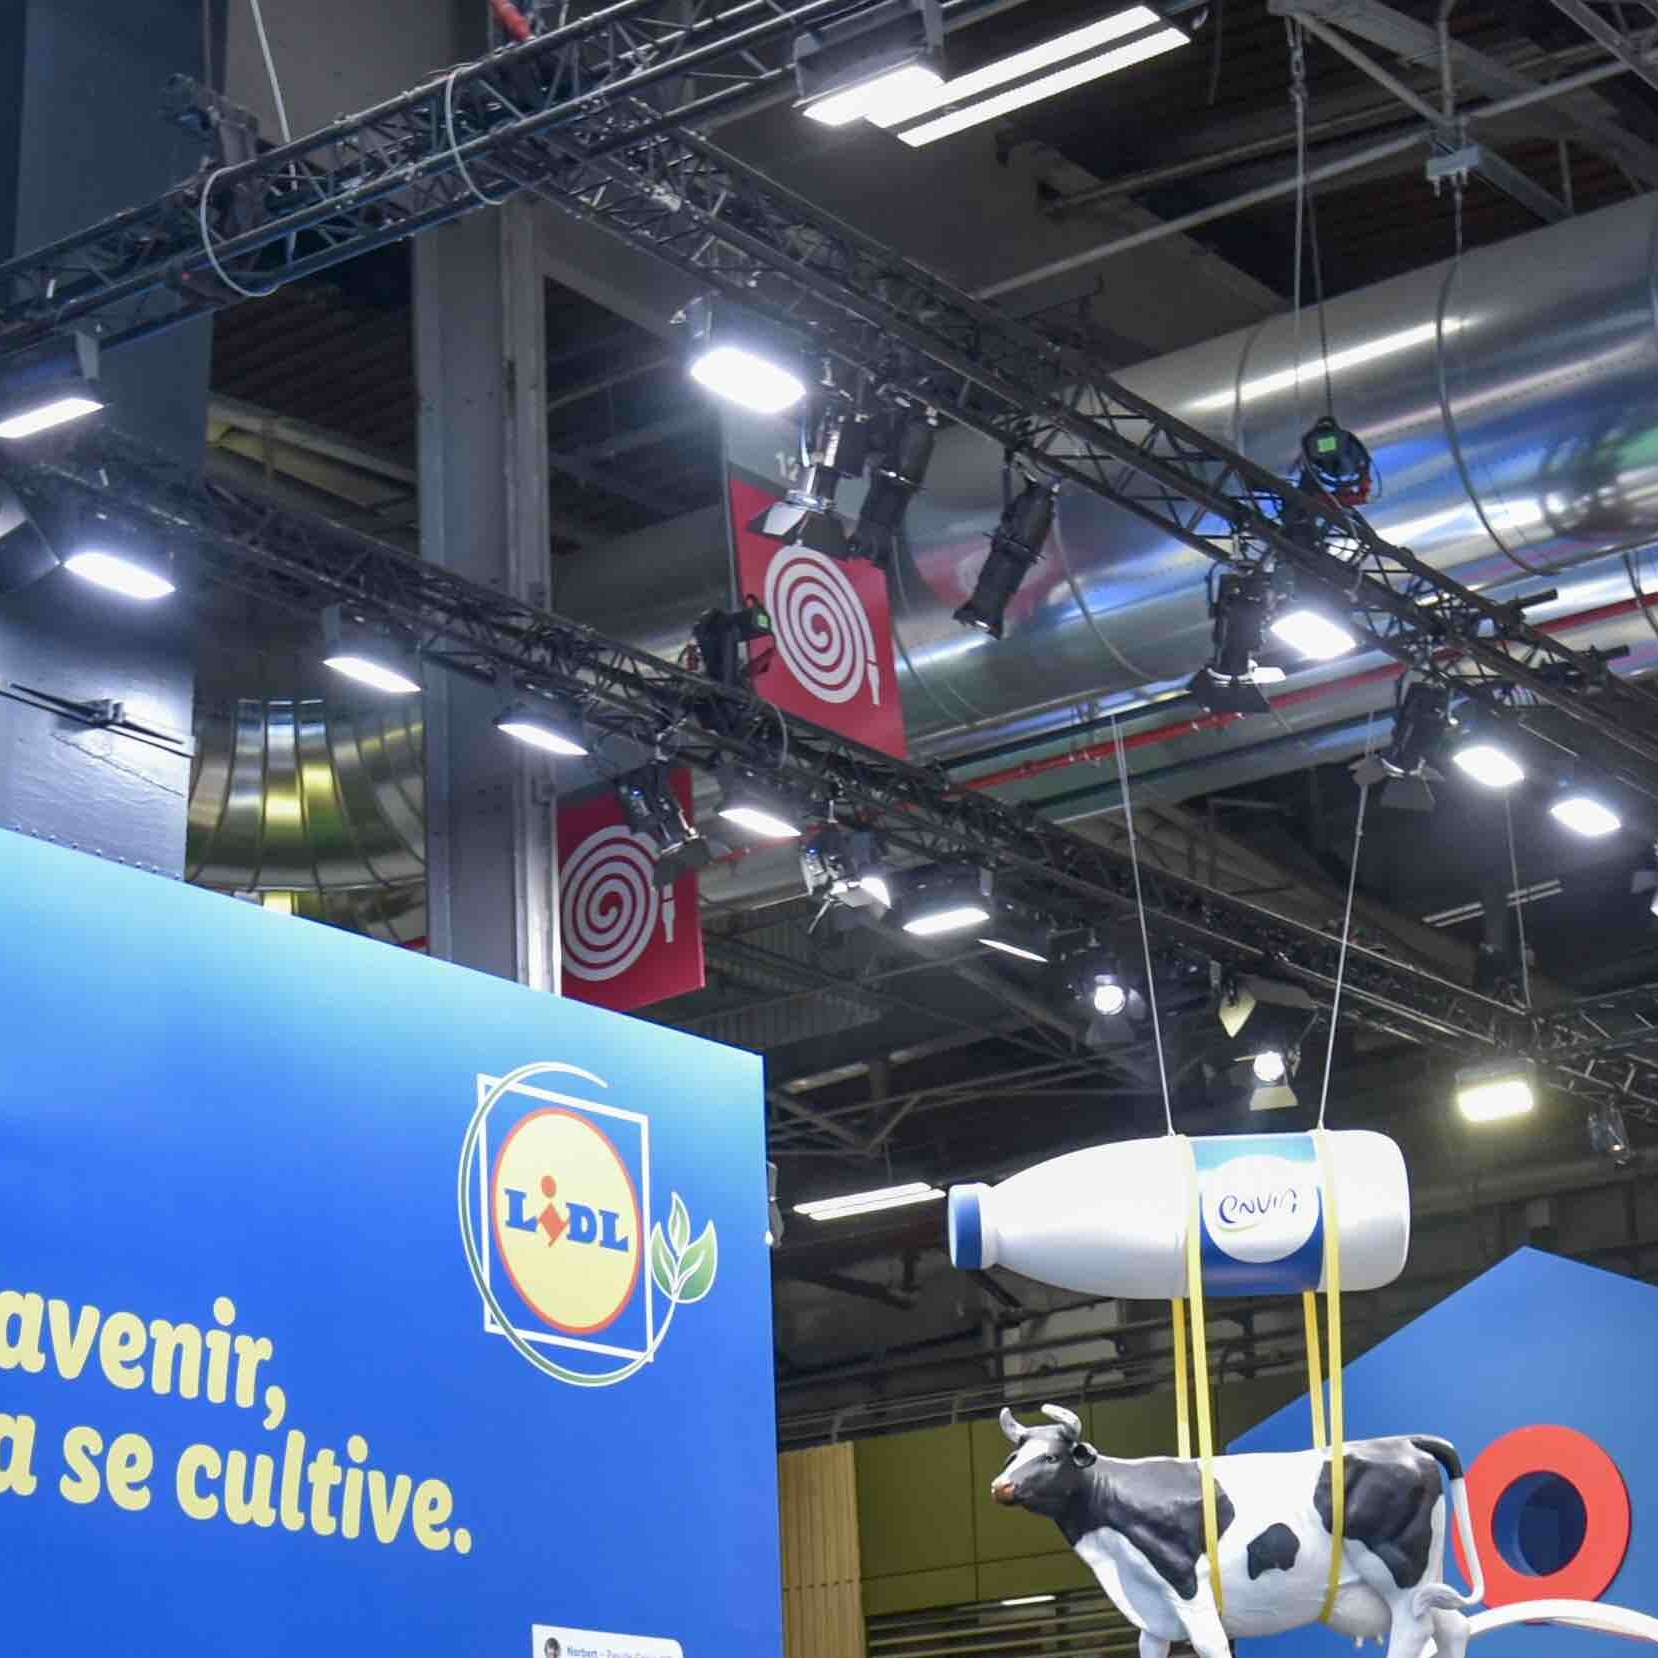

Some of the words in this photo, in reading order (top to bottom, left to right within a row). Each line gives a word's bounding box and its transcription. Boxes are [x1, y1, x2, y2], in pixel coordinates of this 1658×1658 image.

[503, 1174, 630, 1254] LIDL
[59, 1425, 154, 1511] se
[176, 1430, 473, 1555] cultive.
